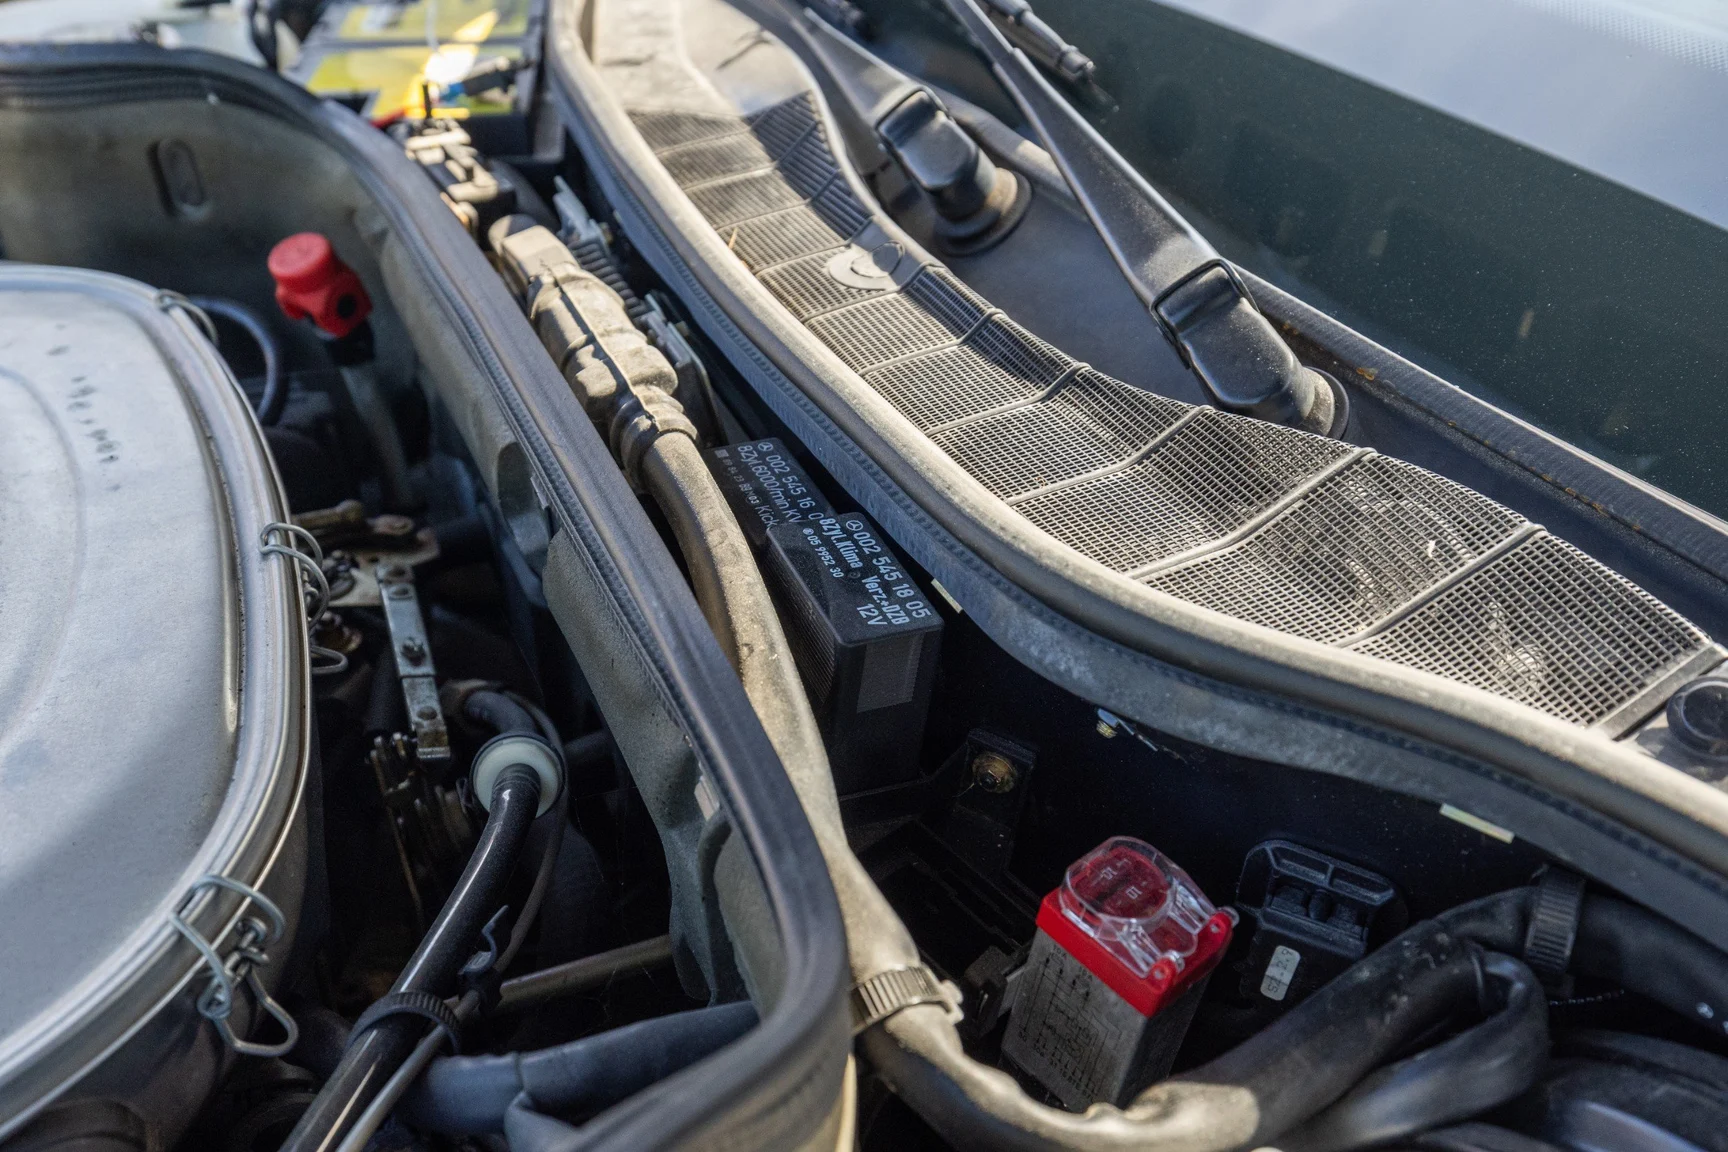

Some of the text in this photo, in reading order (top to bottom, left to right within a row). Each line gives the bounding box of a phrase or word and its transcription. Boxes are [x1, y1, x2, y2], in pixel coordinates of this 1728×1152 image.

[766, 455, 824, 520] 002 545 16 0
[807, 535, 844, 578] 05 9952 30
[853, 531, 931, 618] 002 545 18 05
[856, 603, 888, 625] 12V
